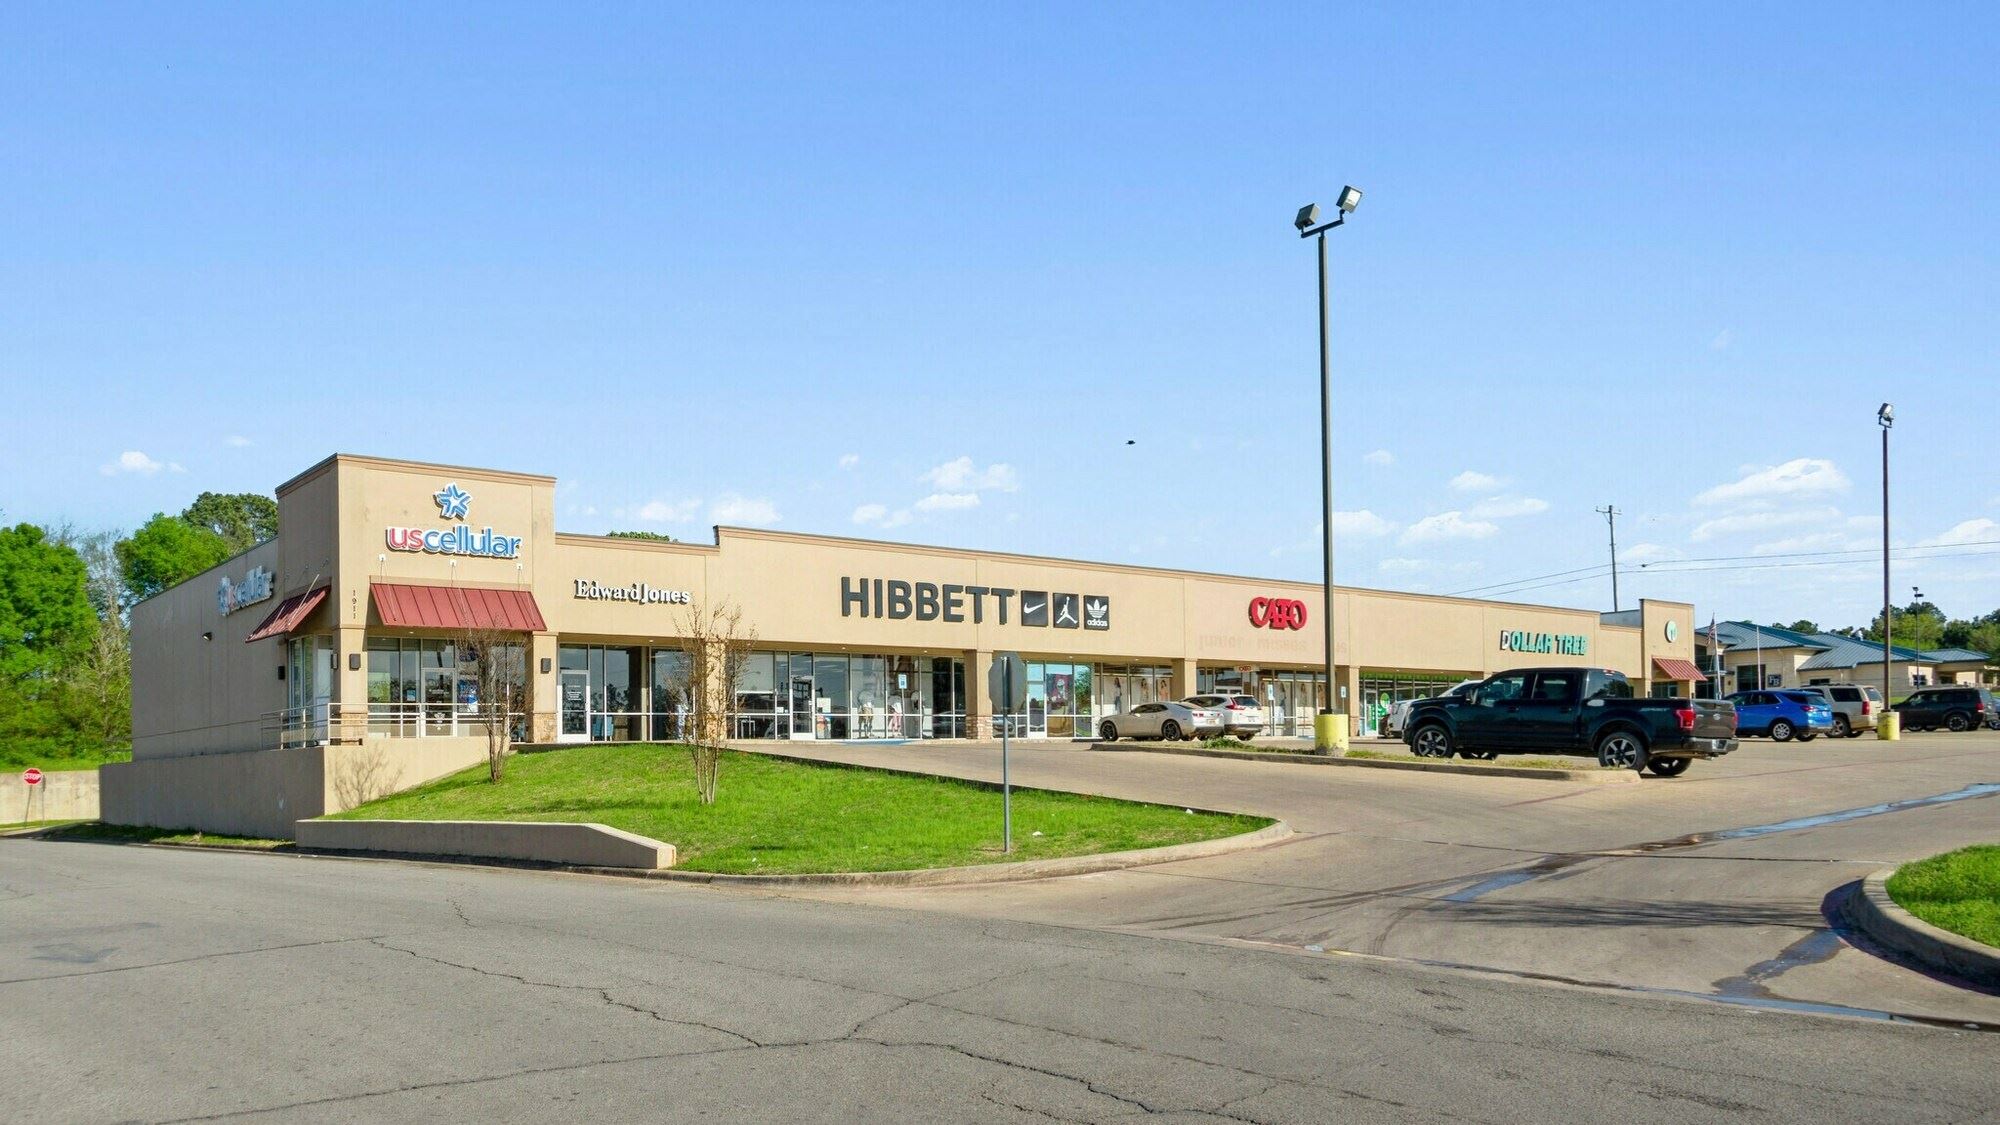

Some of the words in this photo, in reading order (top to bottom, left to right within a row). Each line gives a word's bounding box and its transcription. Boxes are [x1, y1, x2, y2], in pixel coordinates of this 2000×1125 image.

[386, 525, 522, 559] uscellular
[841, 576, 1015, 625] HIBBETT
[1248, 596, 1308, 630] CATO
[1086, 618, 1108, 627] adidas
[1499, 629, 1552, 654] DOLLAR
[1555, 634, 1587, 656] TREE
